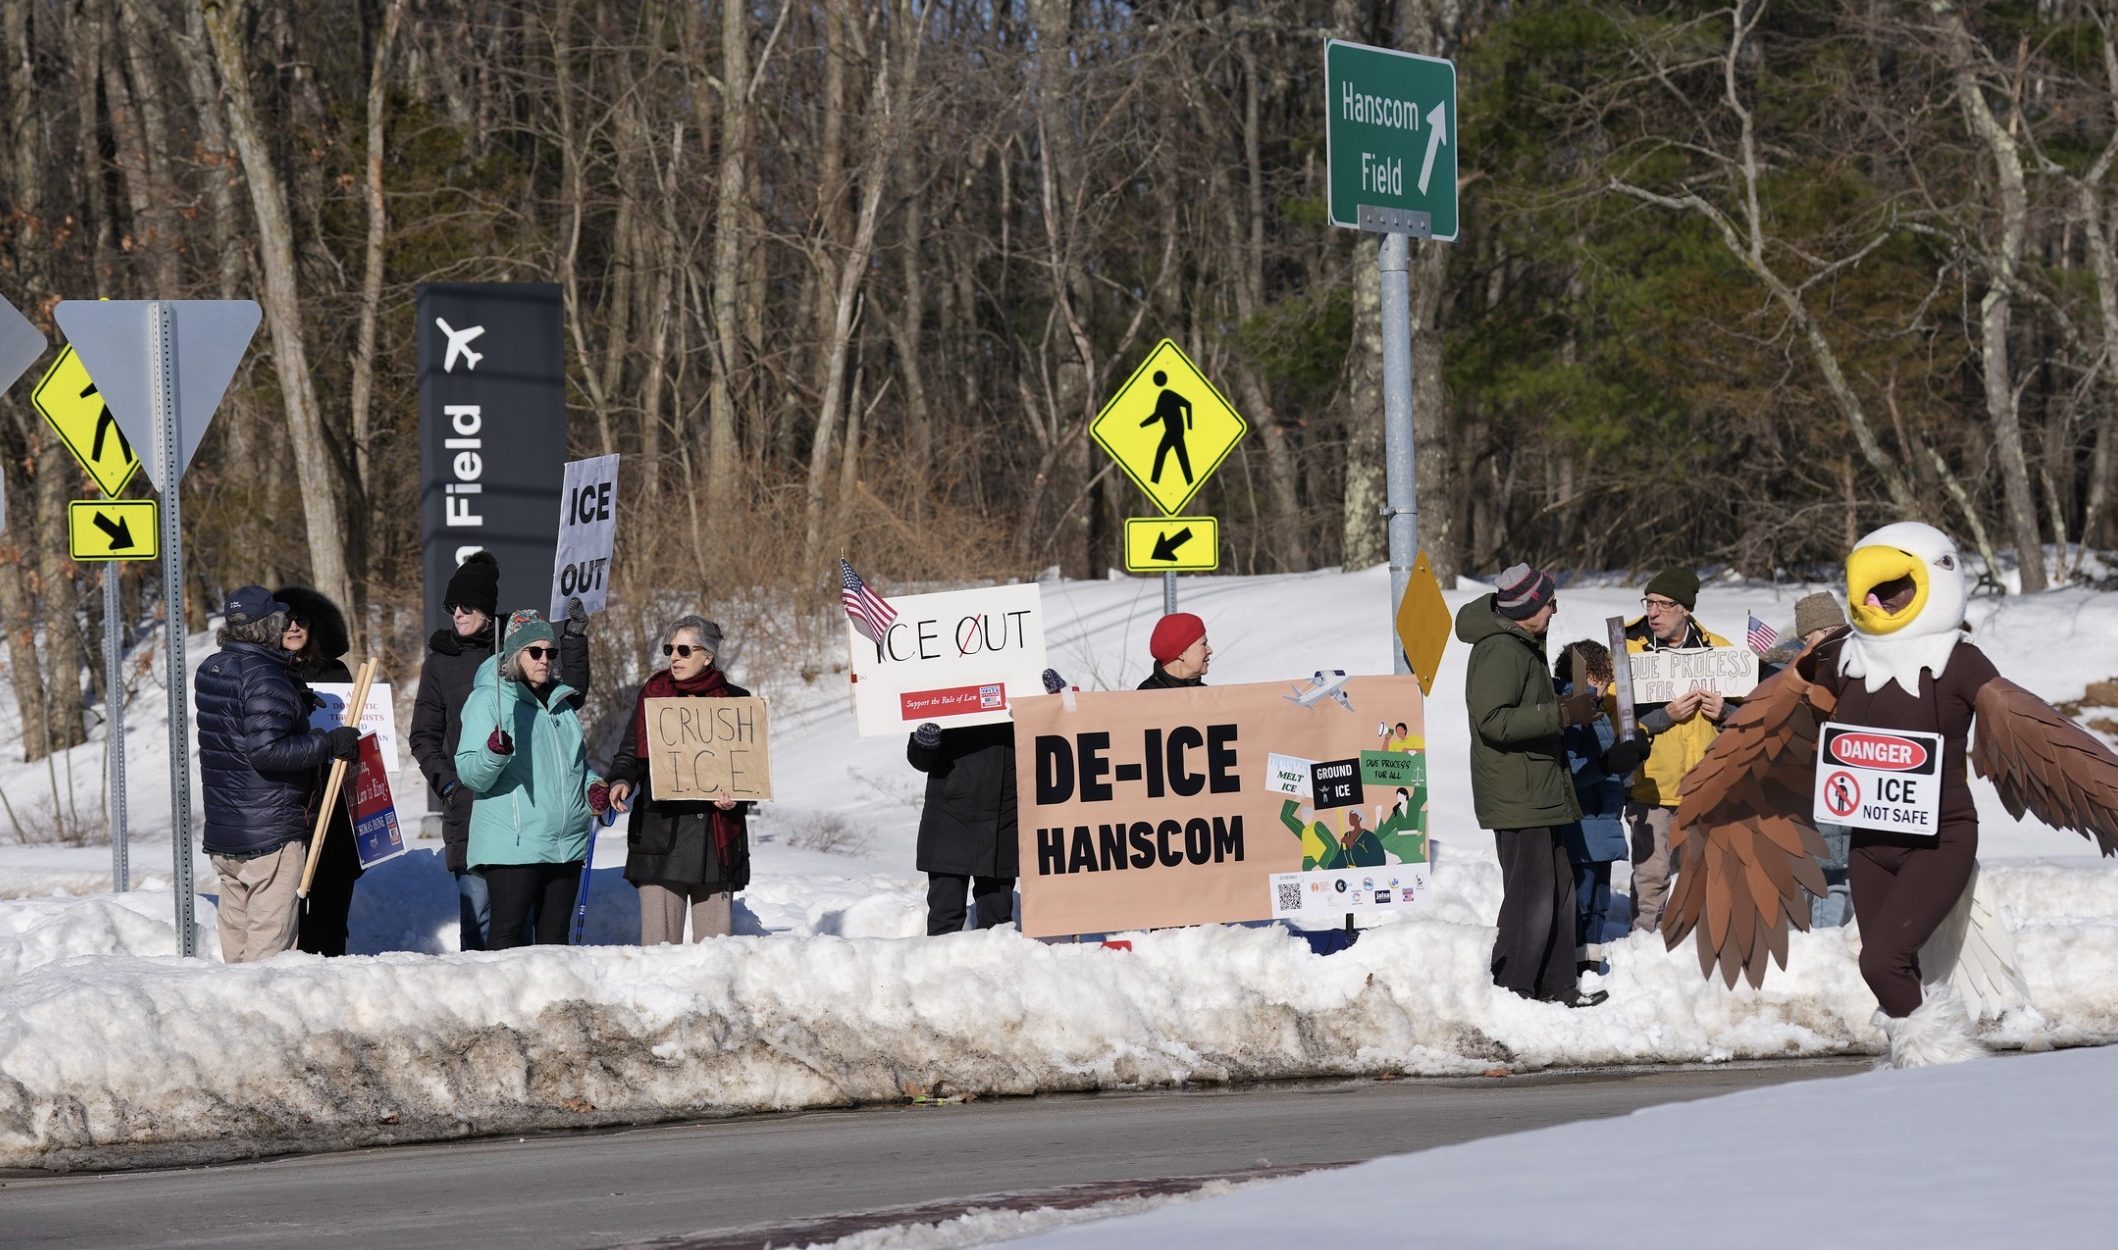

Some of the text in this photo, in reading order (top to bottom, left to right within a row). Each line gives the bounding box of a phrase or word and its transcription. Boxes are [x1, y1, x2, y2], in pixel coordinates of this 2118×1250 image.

[1342, 80, 1419, 131] Hanscom
[1362, 152, 1402, 196] Field
[444, 405, 483, 526] Field
[569, 482, 612, 526] ICE
[561, 558, 607, 597] OUT
[1630, 656, 1659, 680] DUE
[1670, 650, 1751, 679] PROCESS
[906, 693, 977, 709] Support the Rule of Law
[1646, 681, 1676, 702] FOR
[659, 706, 753, 746] CRUSH
[1035, 724, 1240, 805] DE-ICE
[1365, 759, 1411, 769] DUE PROCESS
[1840, 738, 1912, 765] DANGER
[667, 749, 760, 795] I.C.E.
[1277, 770, 1304, 783] MELT
[1316, 764, 1353, 780] GROUND
[1374, 771, 1402, 780] FOR ALL
[1281, 783, 1297, 793] ICE
[1335, 784, 1351, 798] ICE
[1877, 777, 1917, 804] ICE
[1863, 804, 1929, 826] NOT SAFE
[1036, 815, 1244, 875] HANSCOM
